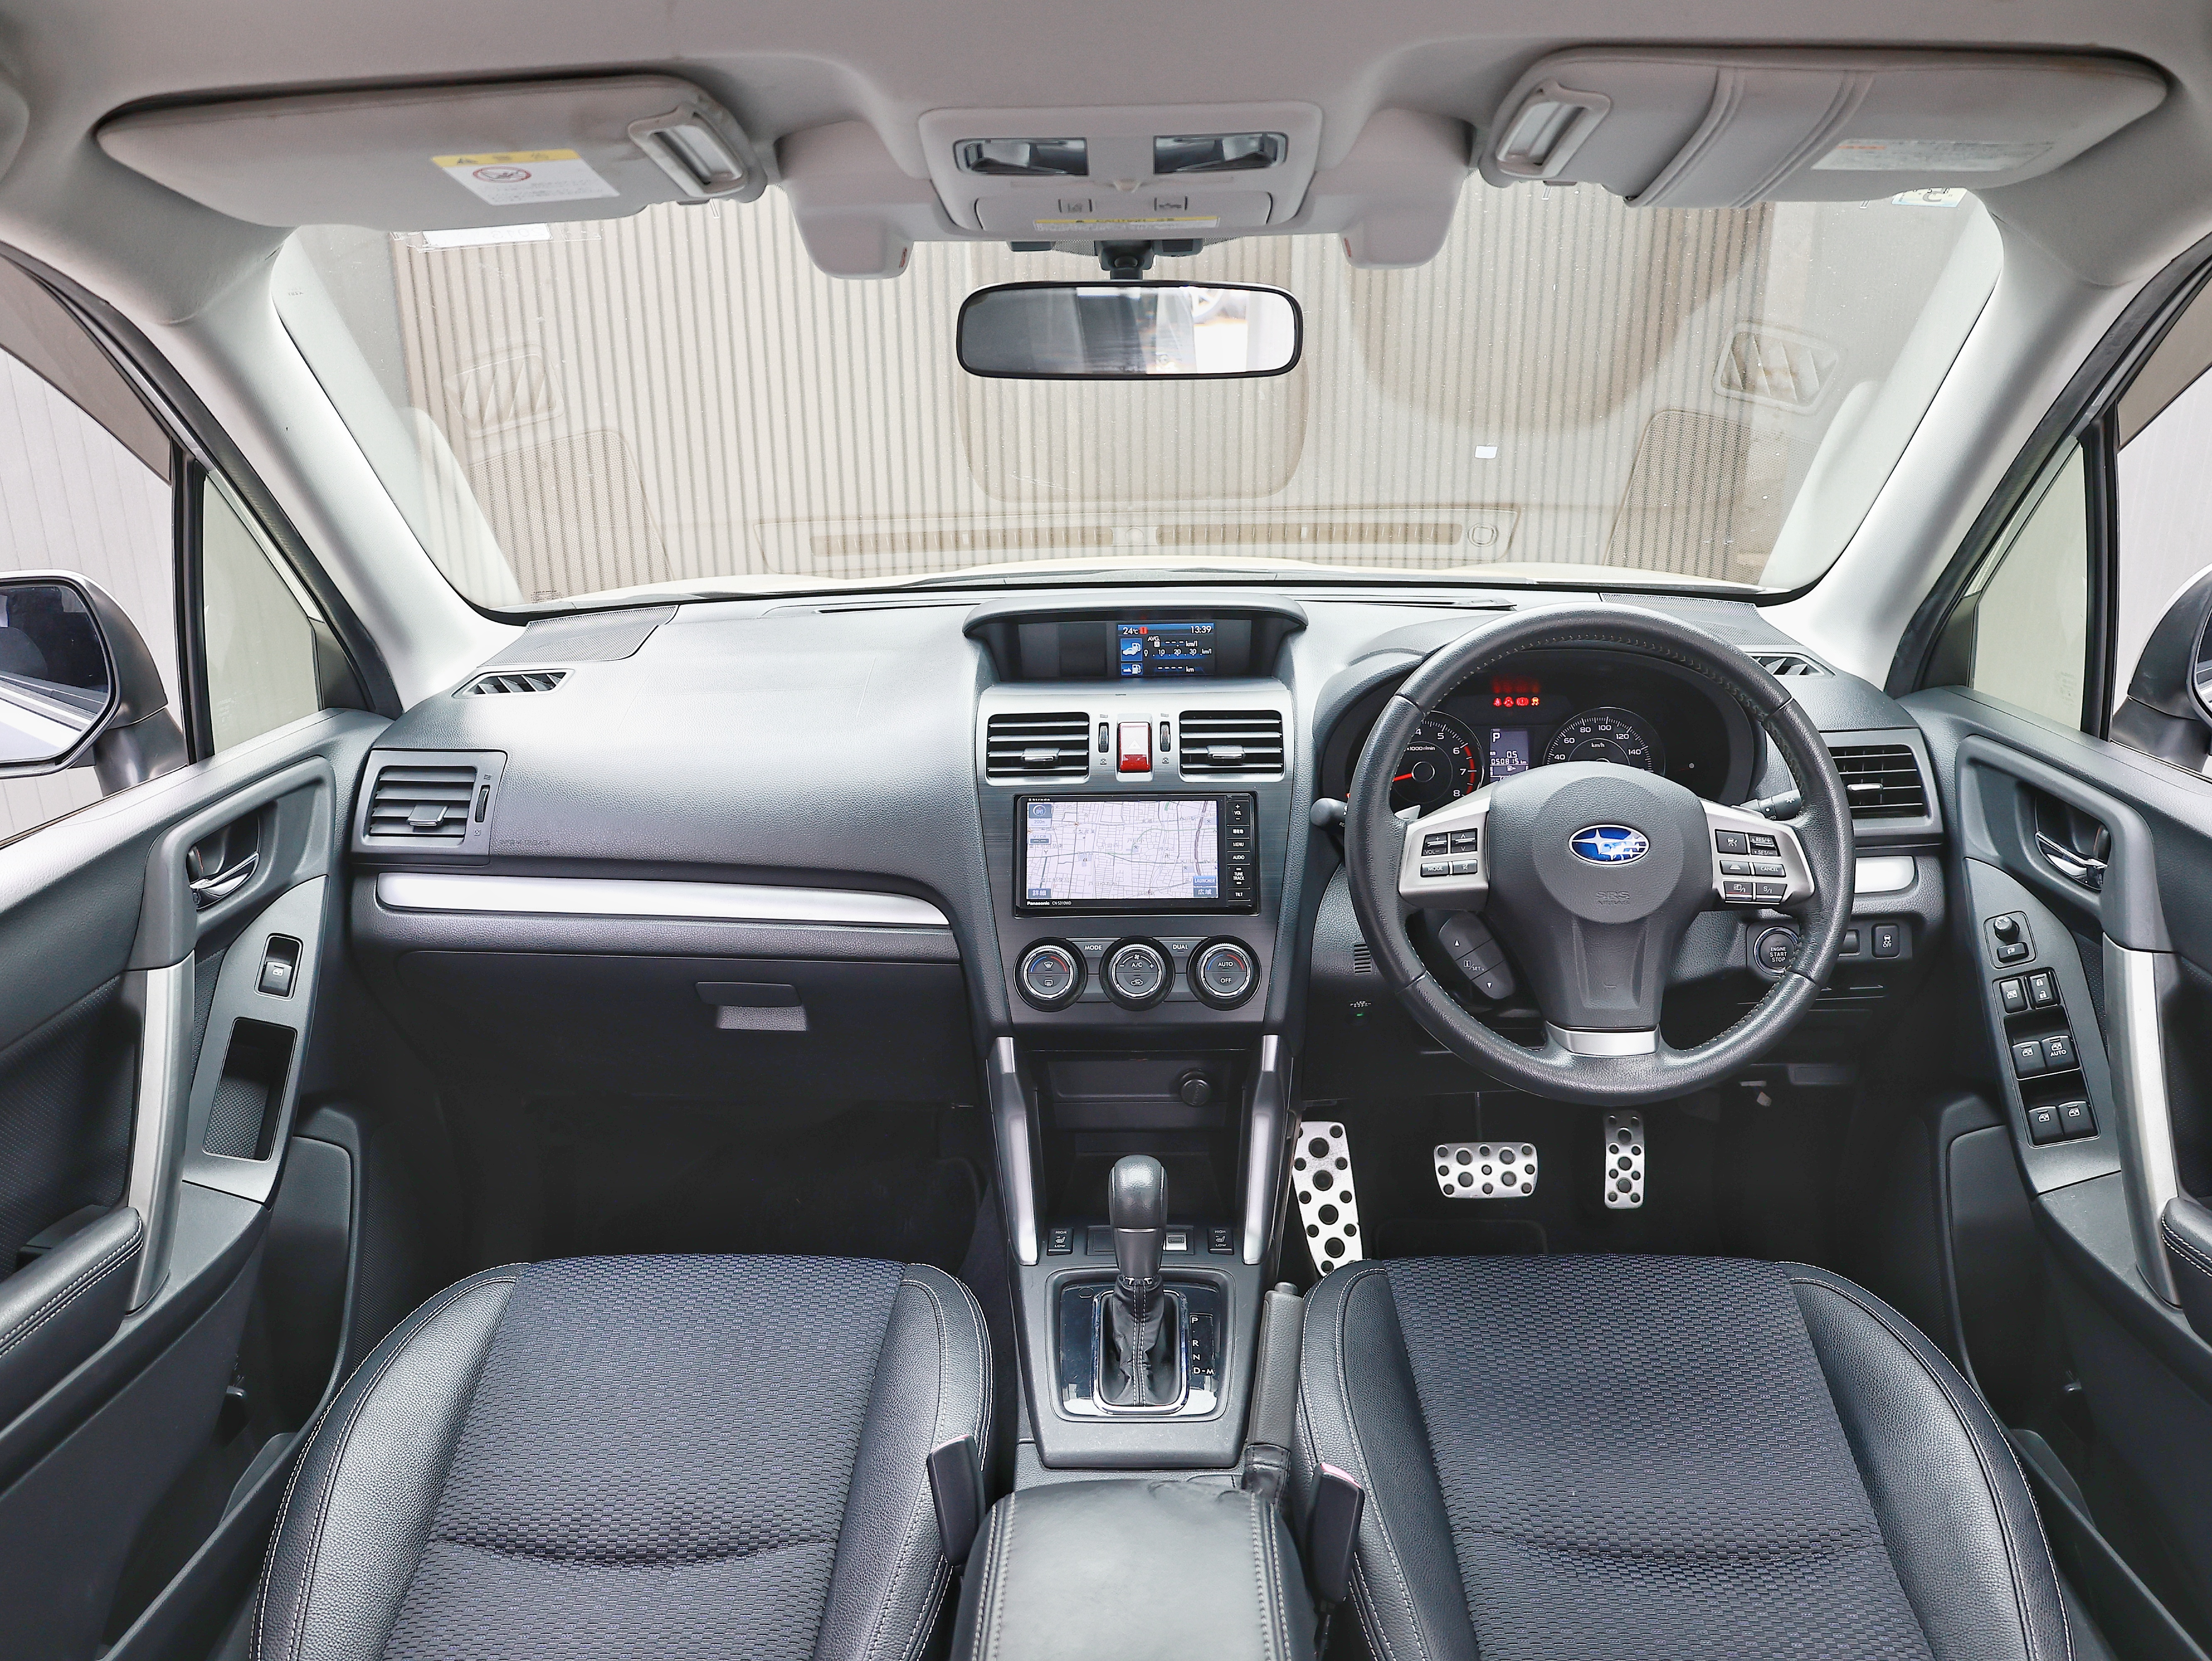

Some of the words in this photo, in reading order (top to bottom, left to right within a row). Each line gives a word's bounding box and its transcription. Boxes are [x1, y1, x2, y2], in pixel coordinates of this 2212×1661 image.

[1191, 625, 1212, 634] 13:39
[1493, 732, 1500, 742] P
[2050, 1049, 2067, 1057] AUTO
